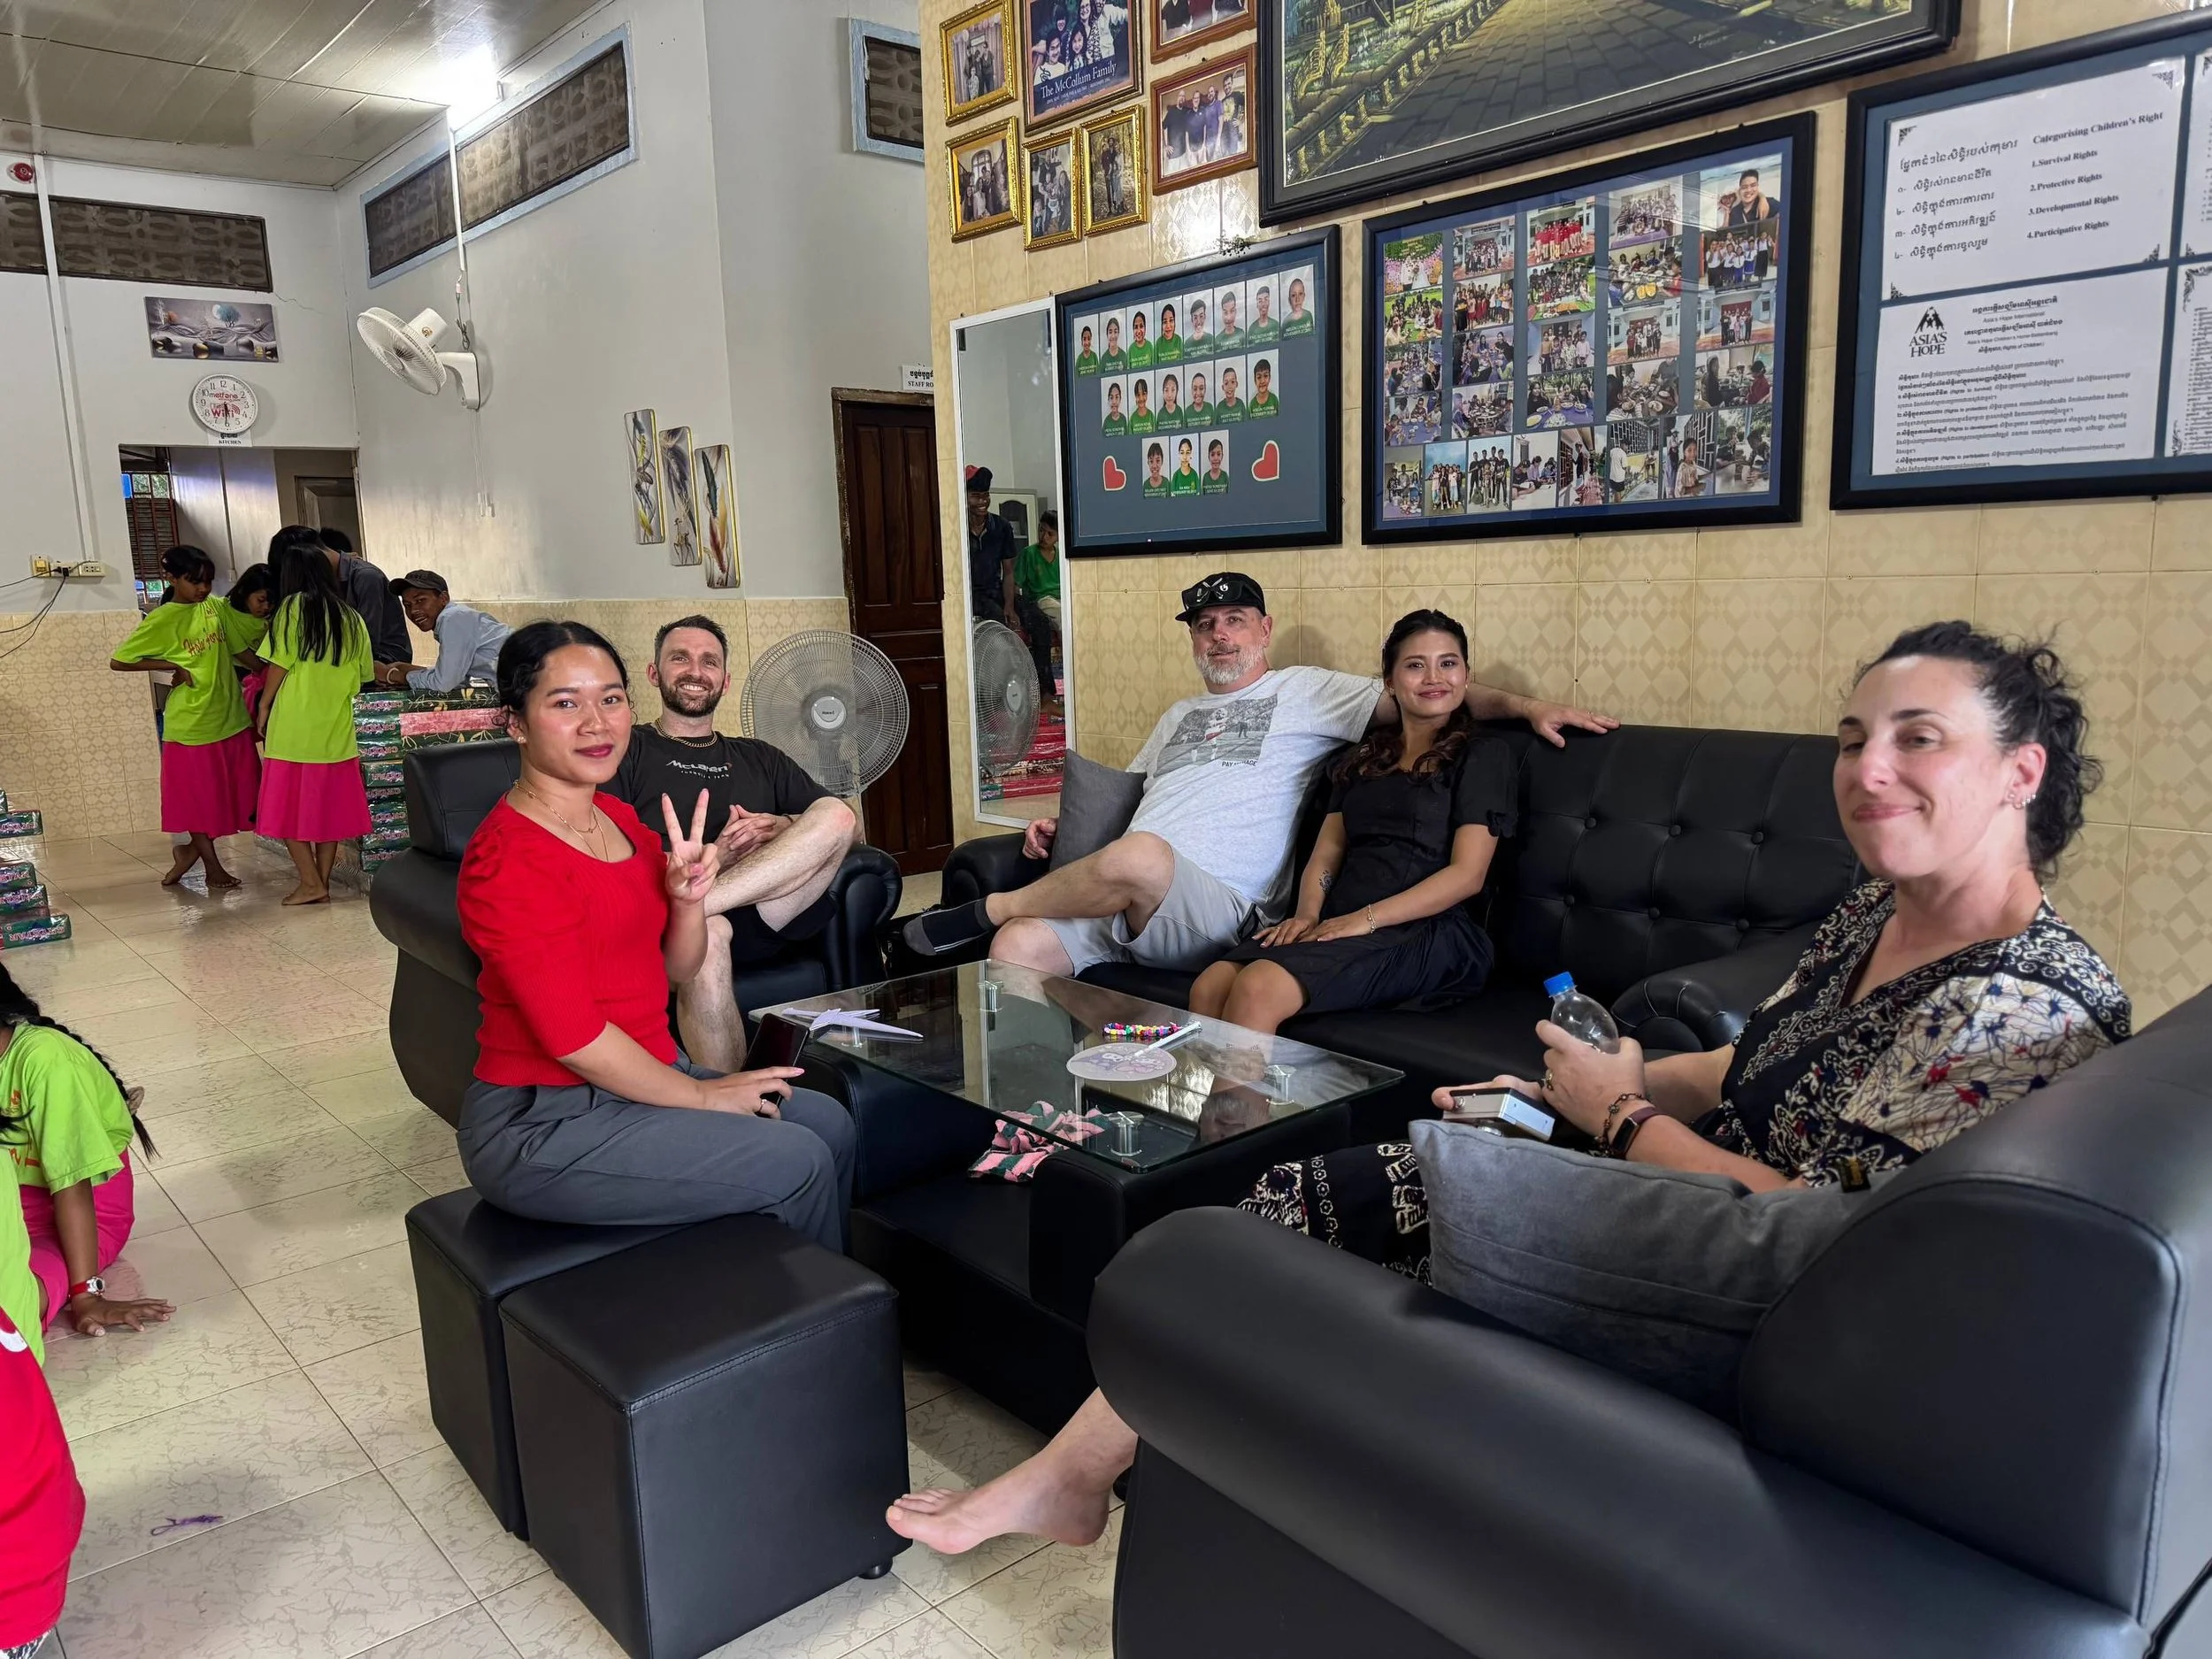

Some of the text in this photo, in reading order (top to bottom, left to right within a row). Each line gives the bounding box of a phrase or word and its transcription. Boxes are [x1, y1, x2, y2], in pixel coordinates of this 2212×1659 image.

[1041, 86, 1053, 98] The
[1055, 73, 1091, 94] McCollum
[1093, 61, 1117, 79] Family
[2032, 127, 2088, 144] Categorising
[2139, 111, 2163, 124] Right
[2073, 150, 2098, 161] Rights
[2078, 173, 2102, 183] Rights
[2093, 195, 2119, 205] Rights
[2084, 221, 2109, 230] Rights
[1909, 331, 1947, 347] ASIA'S
[1910, 343, 1946, 357] HOPE
[201, 398, 206, 407] 9
[665, 760, 729, 772] McLaren
